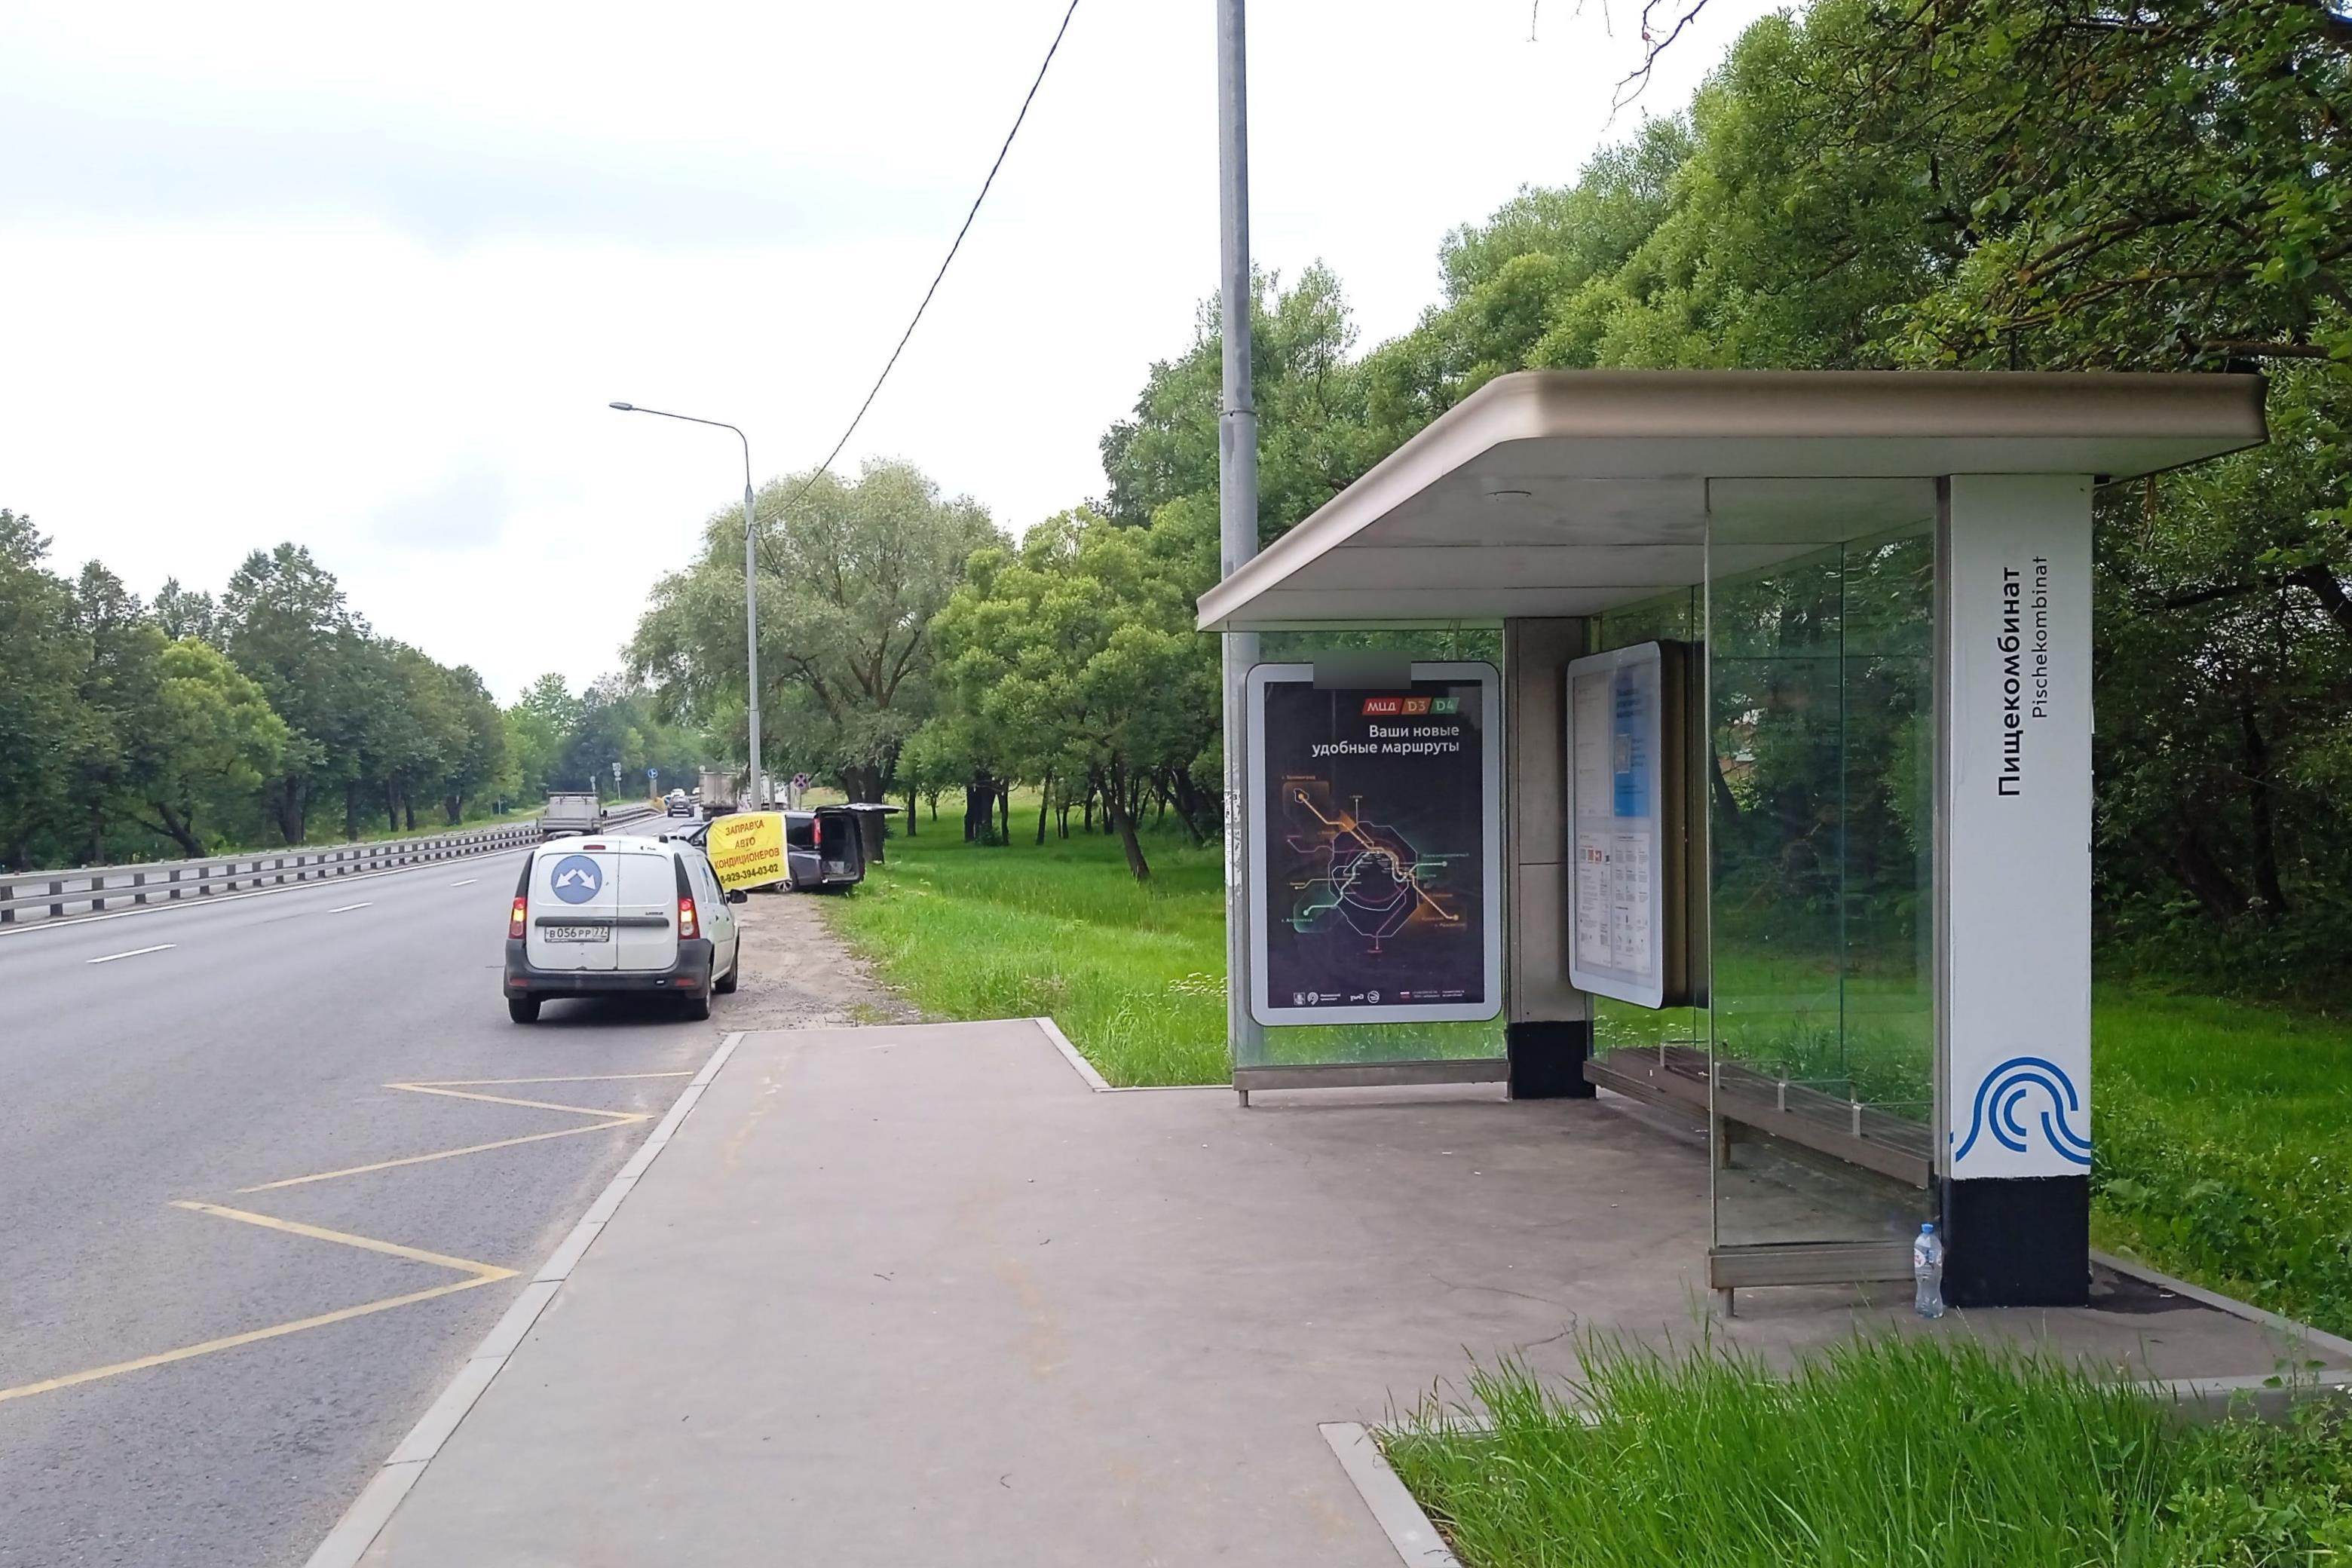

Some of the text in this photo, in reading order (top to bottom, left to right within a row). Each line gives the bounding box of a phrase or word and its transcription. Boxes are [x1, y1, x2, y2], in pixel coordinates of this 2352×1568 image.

[2031, 556, 2047, 718] Pischekombinat
[1998, 567, 2023, 796] Пищекомбинат
[1367, 700, 1454, 712] МЦД D3 D4
[1369, 724, 1459, 738] Ваши новые
[1312, 740, 1459, 758] удобные маршруты
[725, 819, 765, 836] ЗАПРАВКА
[734, 837, 756, 850] АВТО
[714, 847, 780, 869] КОНДИЦИОНЕРОВ
